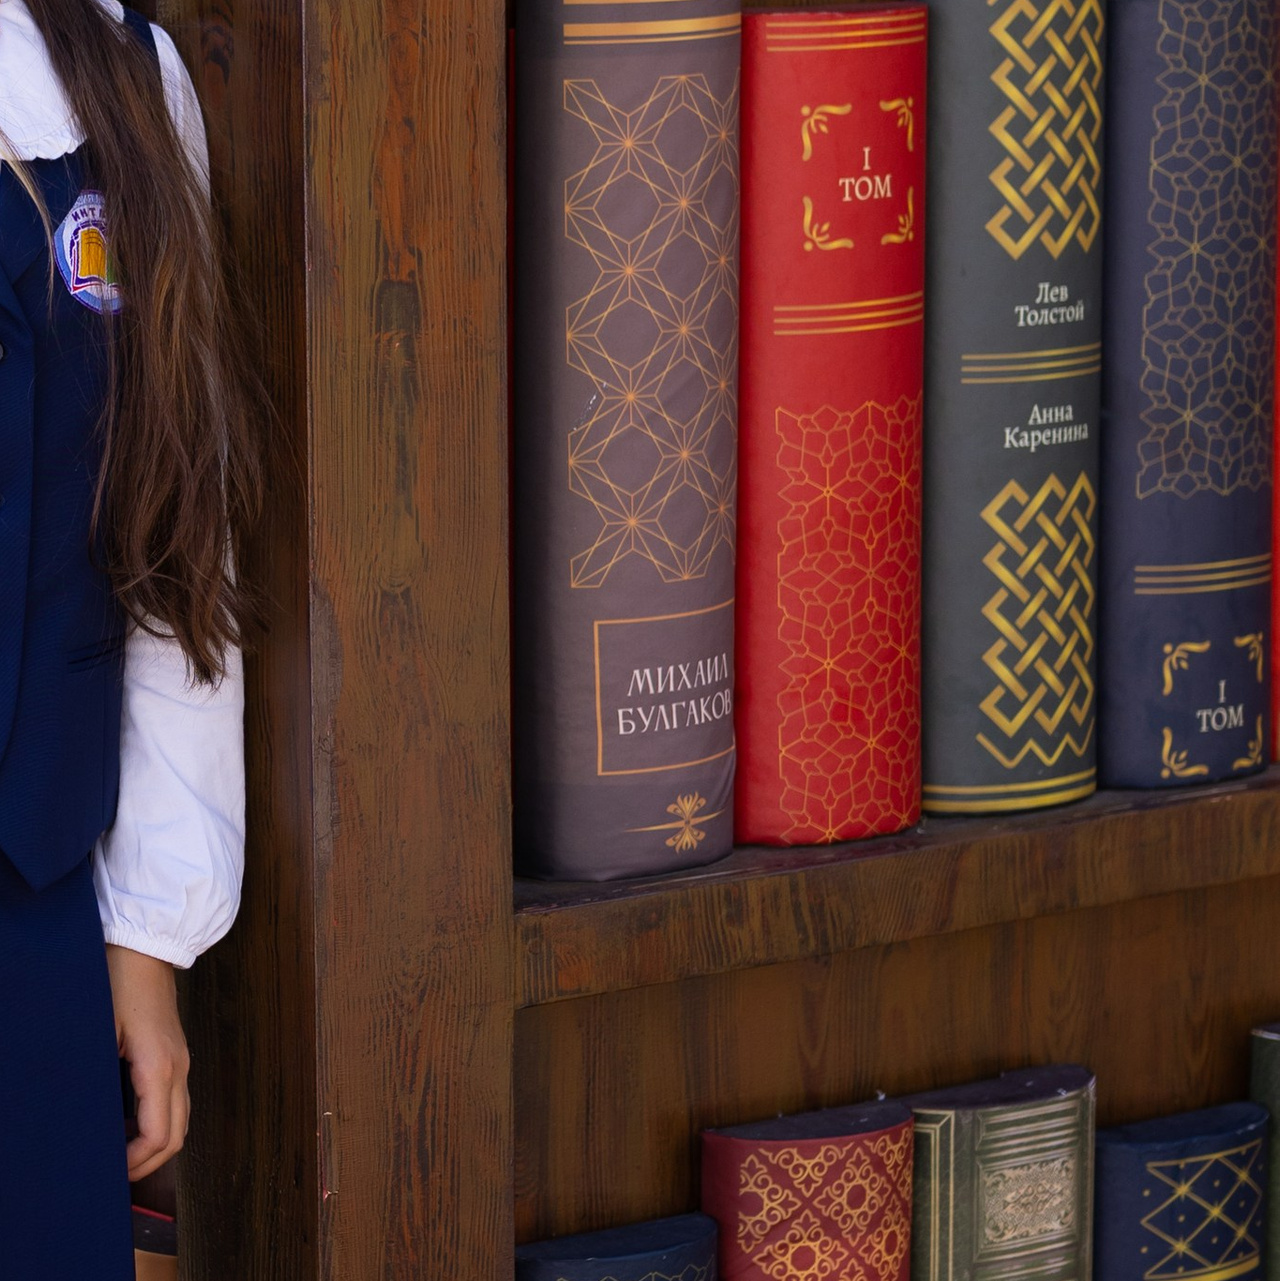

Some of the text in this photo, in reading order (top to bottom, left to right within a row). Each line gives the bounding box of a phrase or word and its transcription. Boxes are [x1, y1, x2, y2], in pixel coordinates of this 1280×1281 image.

[862, 146, 871, 171] I
[838, 173, 892, 202] ТОМ
[1035, 282, 1068, 304] Лев
[1014, 300, 1085, 327] Толстой
[1028, 404, 1073, 425] Анна
[1004, 423, 1089, 453] Каренина
[627, 652, 728, 697] МИХАИЛ
[1219, 679, 1226, 703] I
[617, 688, 732, 735] БУЛГАКОВ
[1196, 703, 1244, 733] ТОМ
